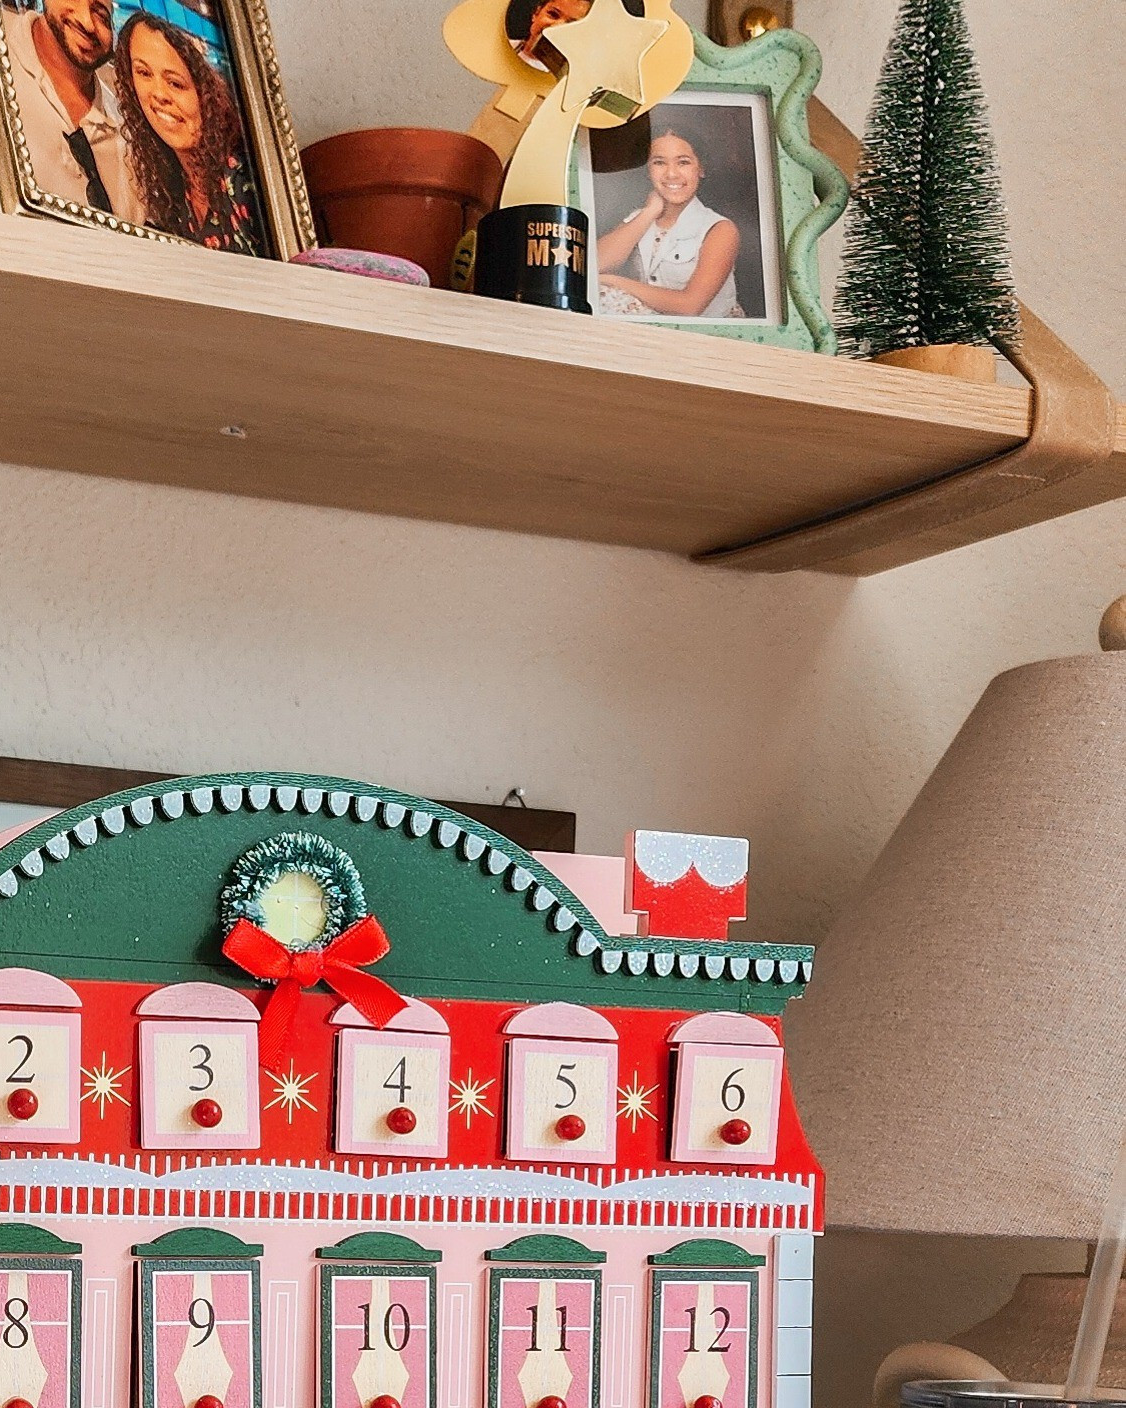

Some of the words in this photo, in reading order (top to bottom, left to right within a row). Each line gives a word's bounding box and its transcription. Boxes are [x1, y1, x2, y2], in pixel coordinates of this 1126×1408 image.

[527, 222, 585, 244] SUPERSTA
[6, 1034, 37, 1084] 2
[188, 1044, 216, 1092] 3
[382, 1056, 412, 1104] 4
[554, 1063, 580, 1108] 5
[720, 1067, 746, 1112] 6
[2, 1298, 30, 1349] 8
[188, 1298, 216, 1348] 9
[357, 1303, 411, 1352] 10
[525, 1305, 572, 1352] 11
[683, 1306, 732, 1353] 12
